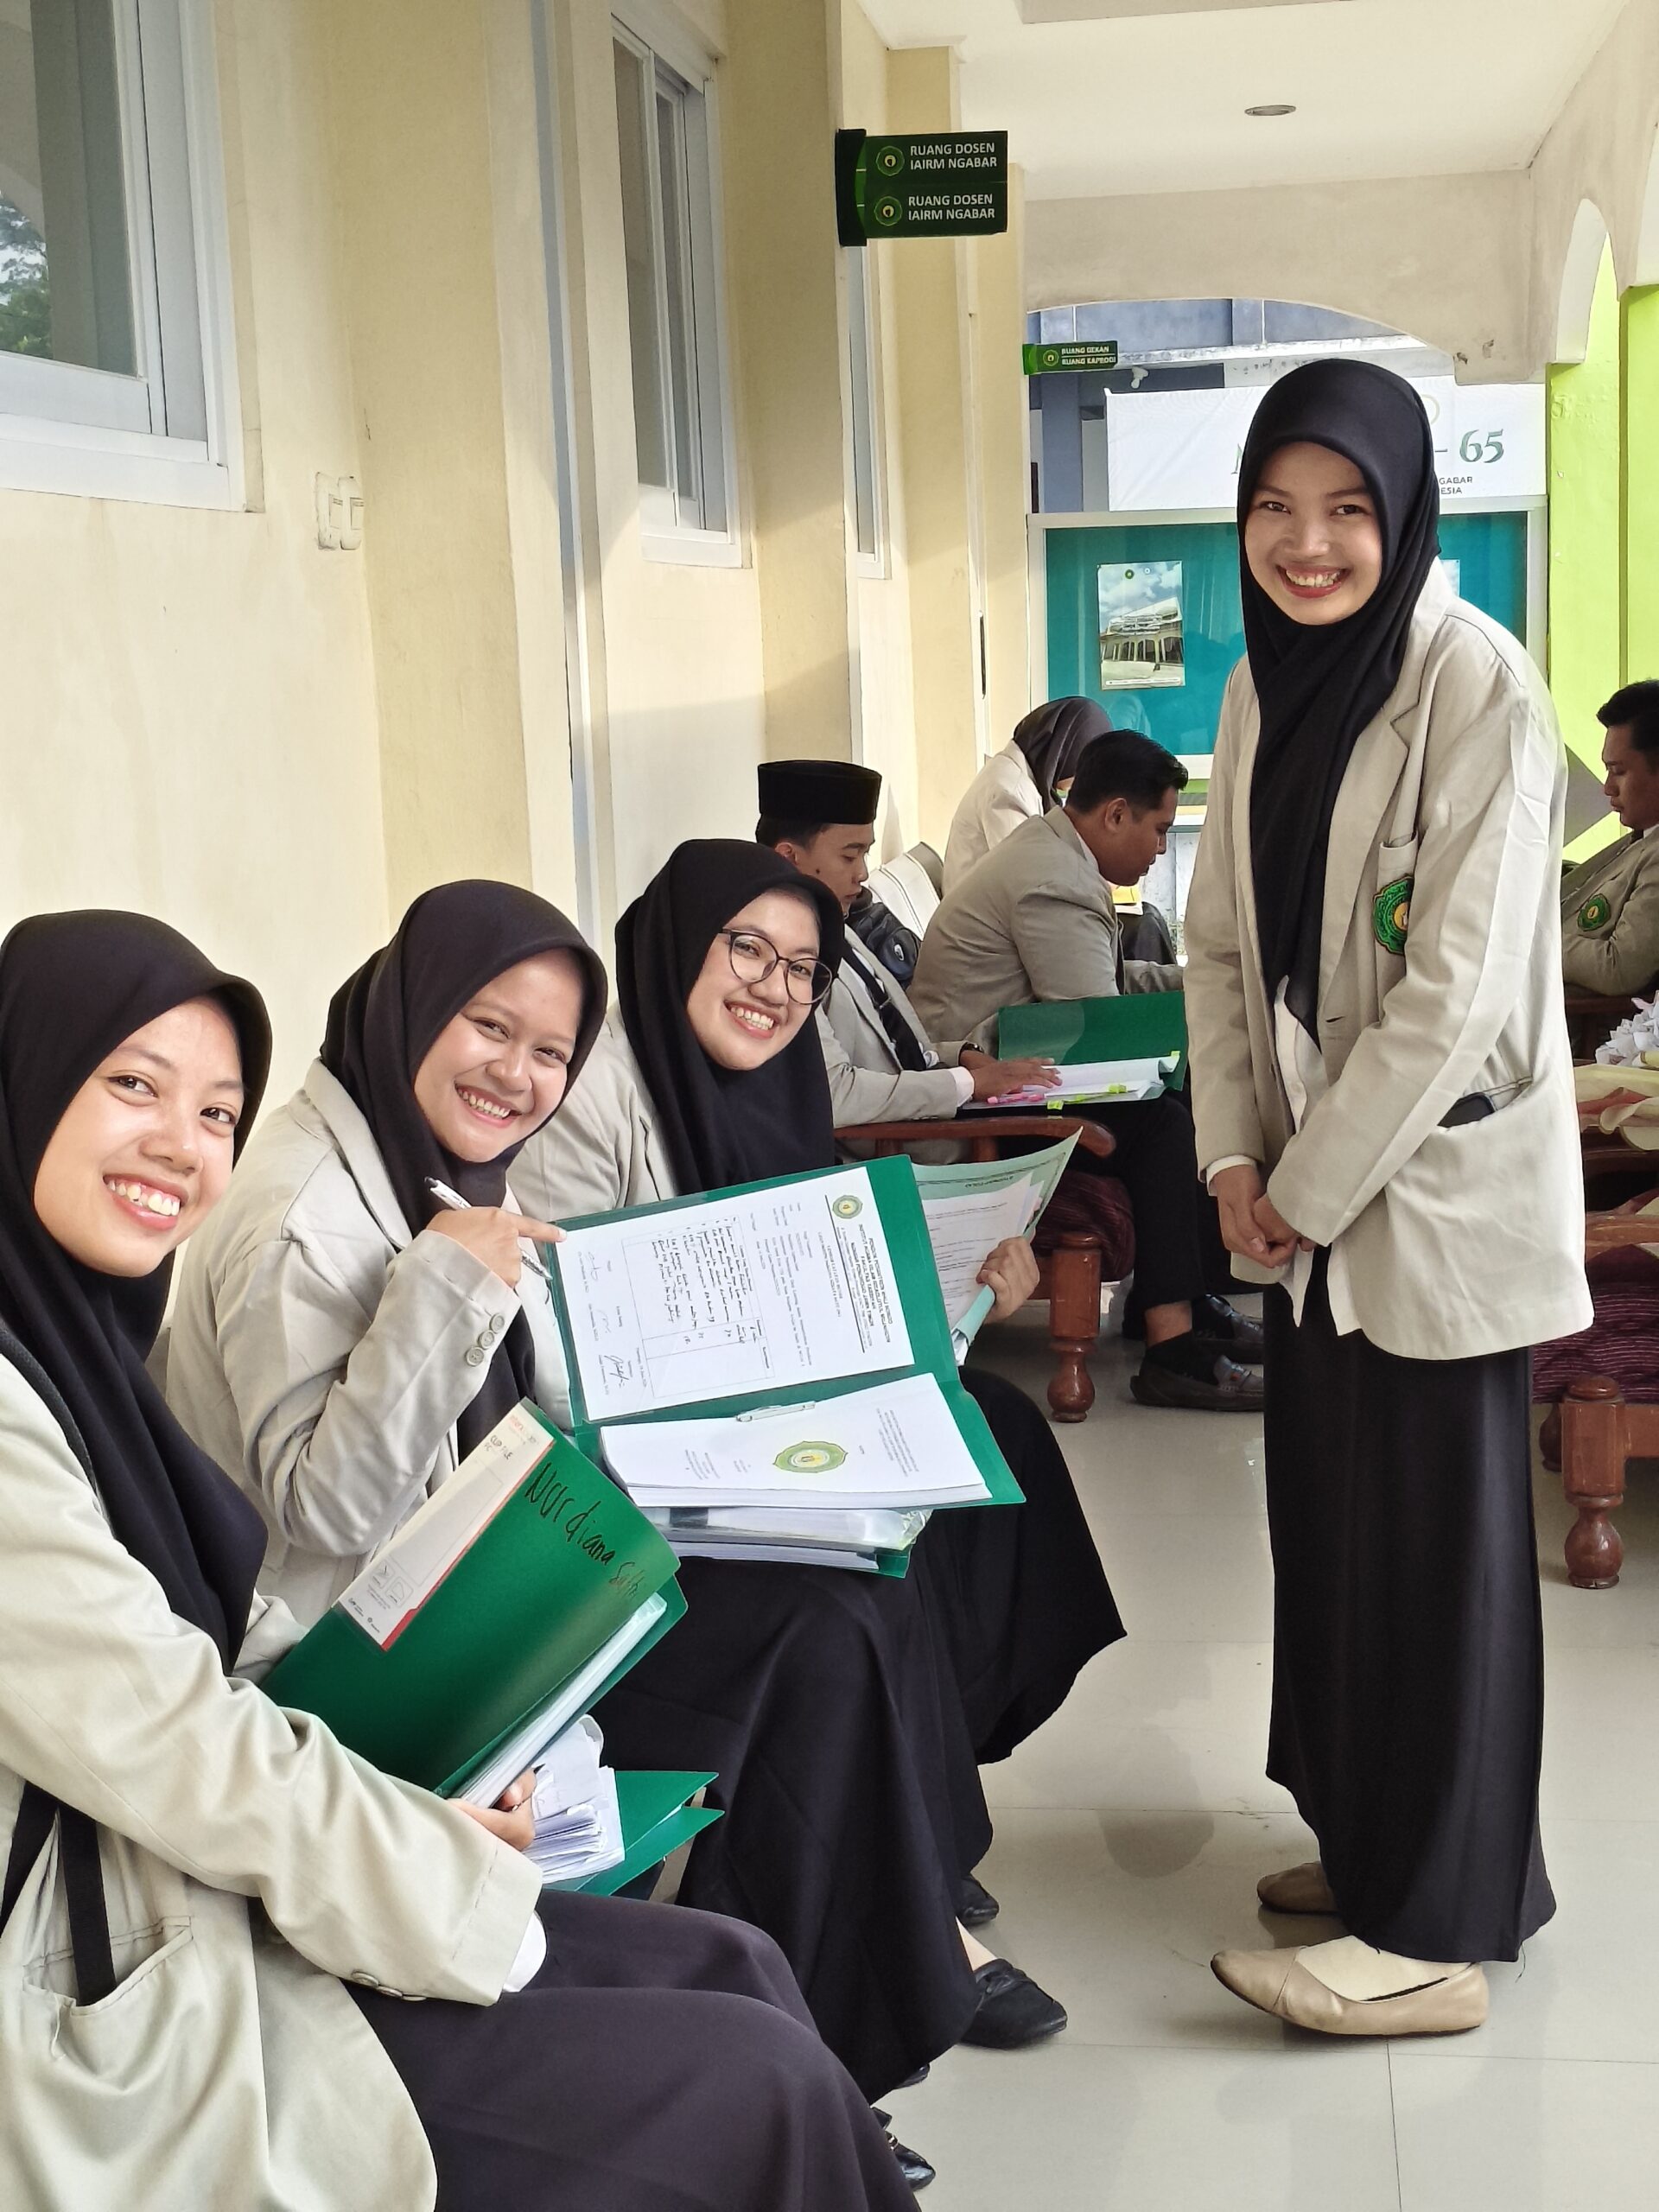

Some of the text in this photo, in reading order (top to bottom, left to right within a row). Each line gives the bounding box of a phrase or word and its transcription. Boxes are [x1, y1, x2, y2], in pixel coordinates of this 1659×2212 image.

[910, 143, 995, 156] RUANG DOSEN
[910, 156, 997, 170] IAIRM NGABAR
[908, 194, 993, 207] RUANG DOSEN
[908, 208, 995, 221] IAIRM NGABAR
[1459, 429, 1504, 463] 65
[1439, 476, 1473, 485] GABAR
